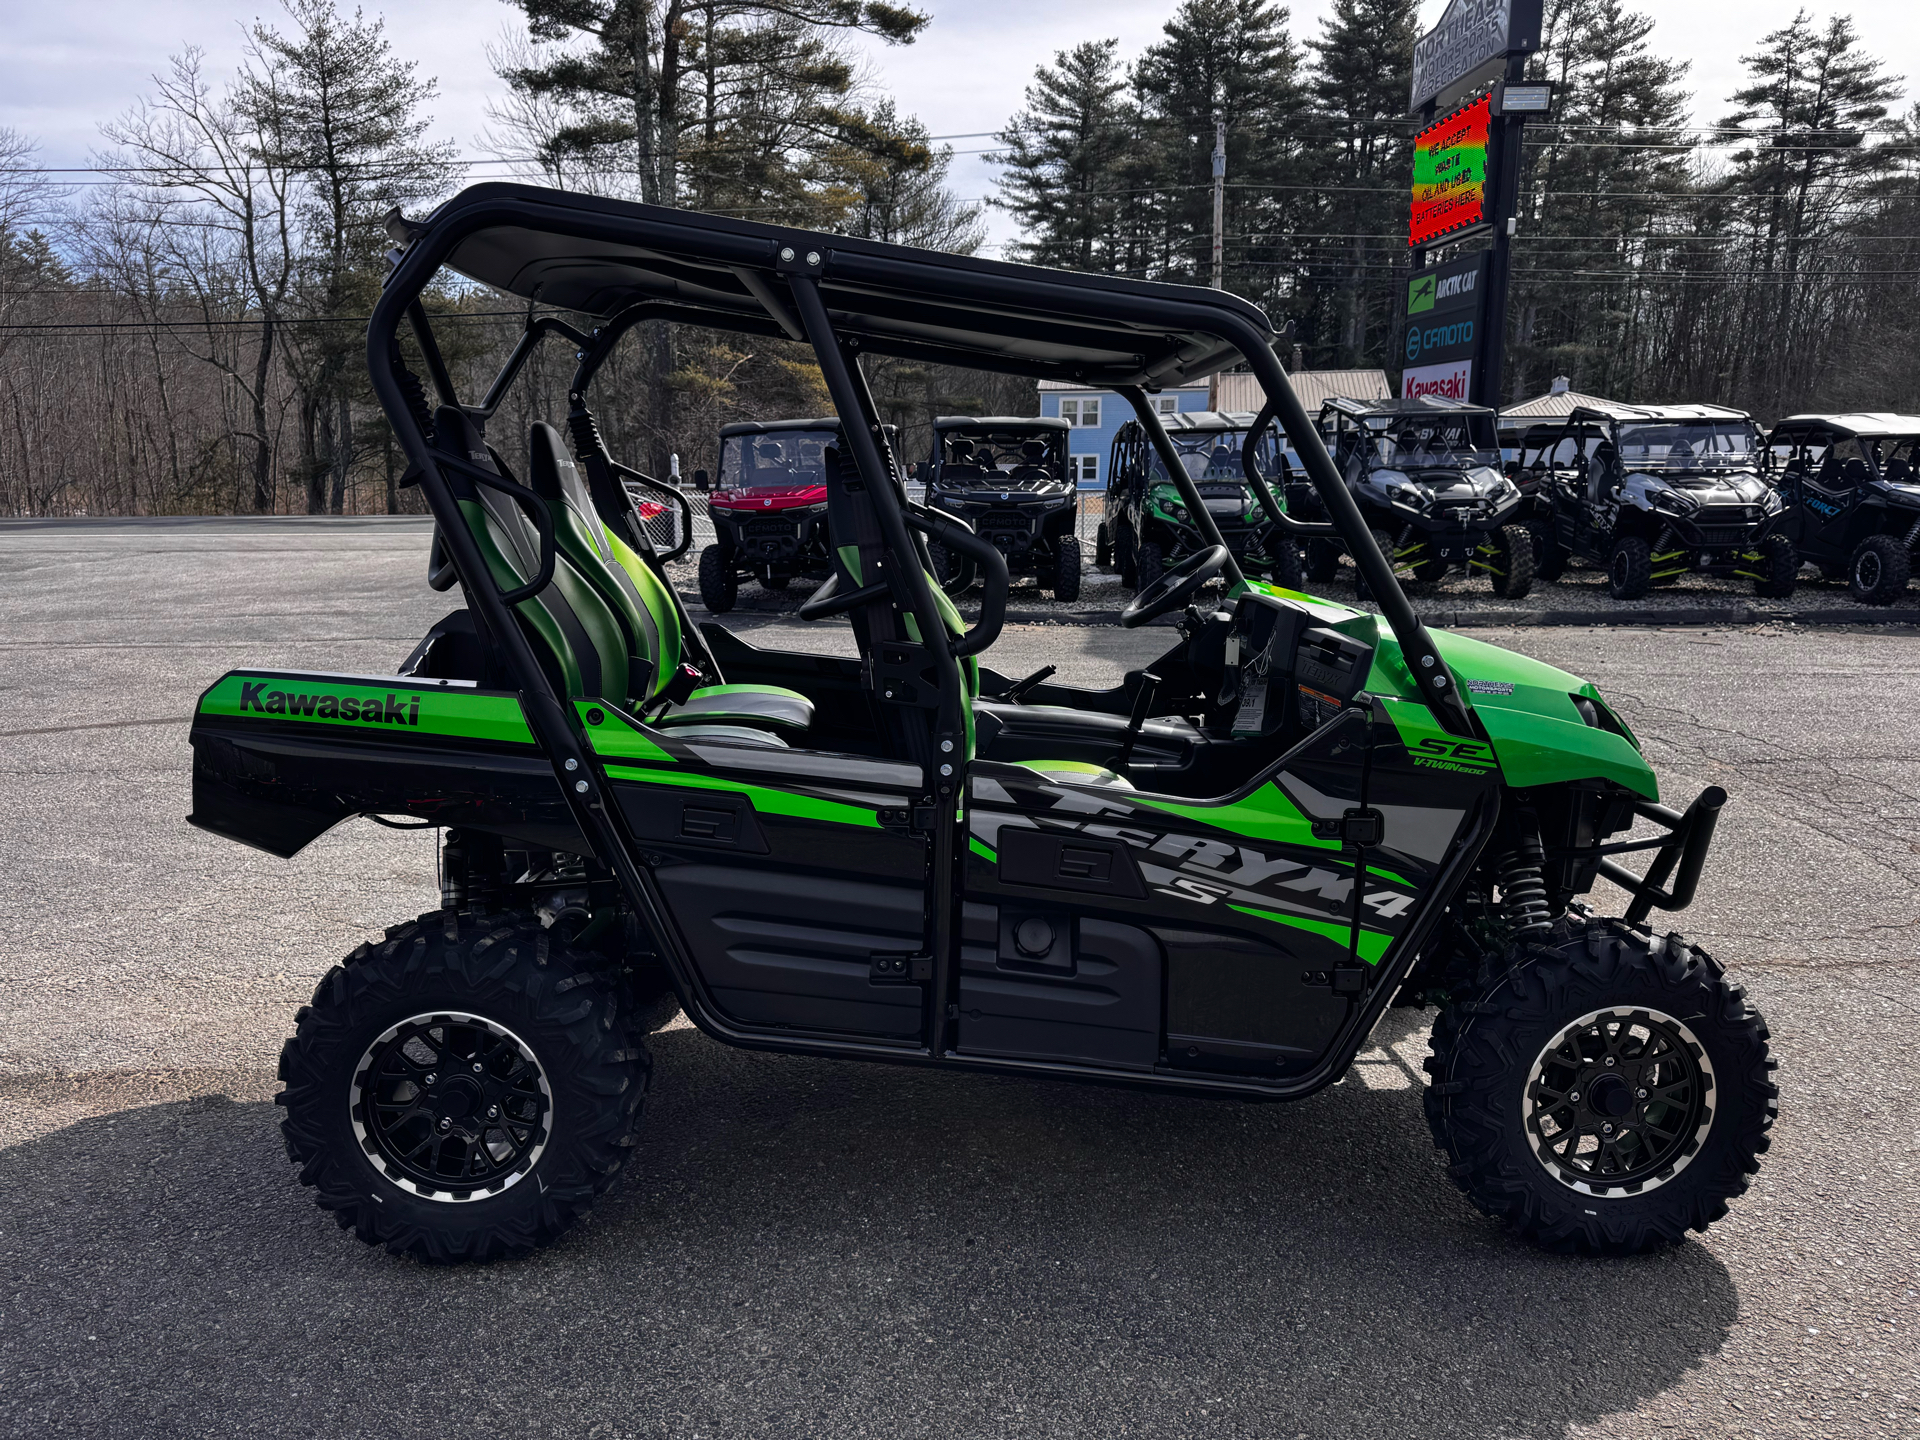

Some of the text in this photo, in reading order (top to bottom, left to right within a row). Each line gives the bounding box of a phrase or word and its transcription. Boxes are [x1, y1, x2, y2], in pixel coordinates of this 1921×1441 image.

[1421, 14, 1499, 81] MOTORSPORTS
[1427, 37, 1495, 95] RECREATION
[1441, 125, 1472, 152] ACCEPT
[1422, 187, 1433, 202] OIL
[1434, 178, 1450, 197] AND
[1416, 187, 1476, 225] BATTERIES HERE
[1436, 269, 1479, 300] ARCTIC CAT
[1423, 321, 1474, 350] CFMOTO
[1406, 370, 1466, 400] Kawasaki
[240, 682, 421, 726] Kawasaki
[1419, 738, 1488, 758] SE
